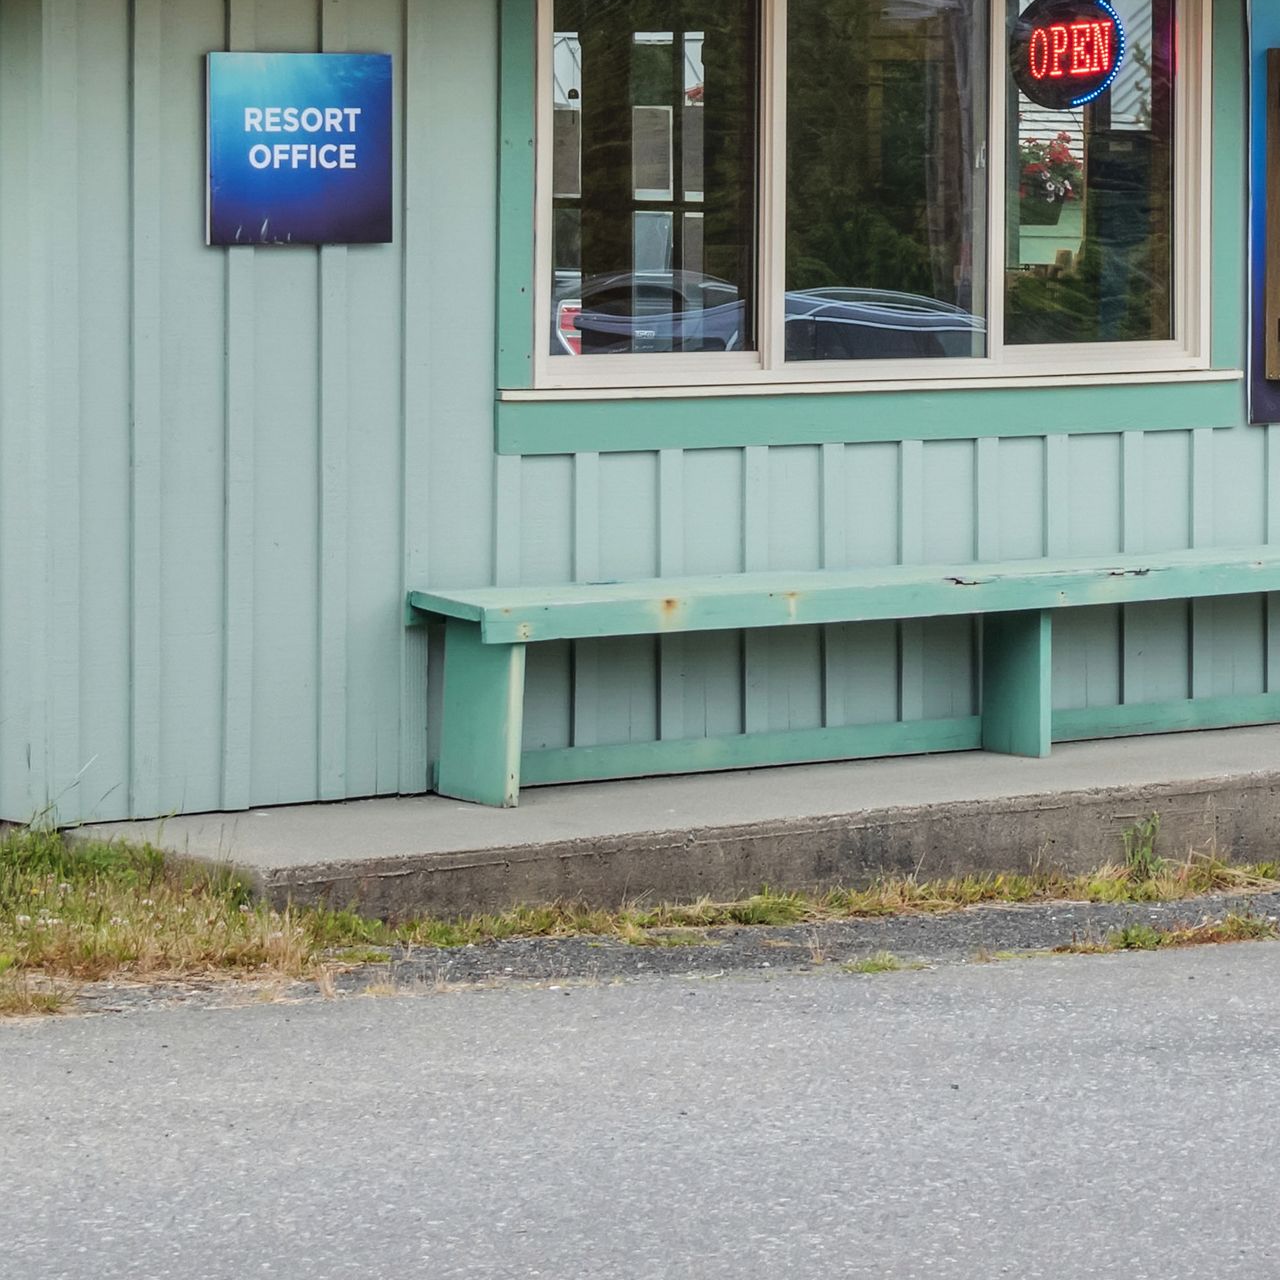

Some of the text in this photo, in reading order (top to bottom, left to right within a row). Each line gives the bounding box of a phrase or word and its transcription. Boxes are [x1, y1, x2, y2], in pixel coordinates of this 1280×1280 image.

[1029, 21, 1112, 79] OPEN
[244, 107, 361, 132] RESORT
[248, 144, 356, 169] OFFICE
